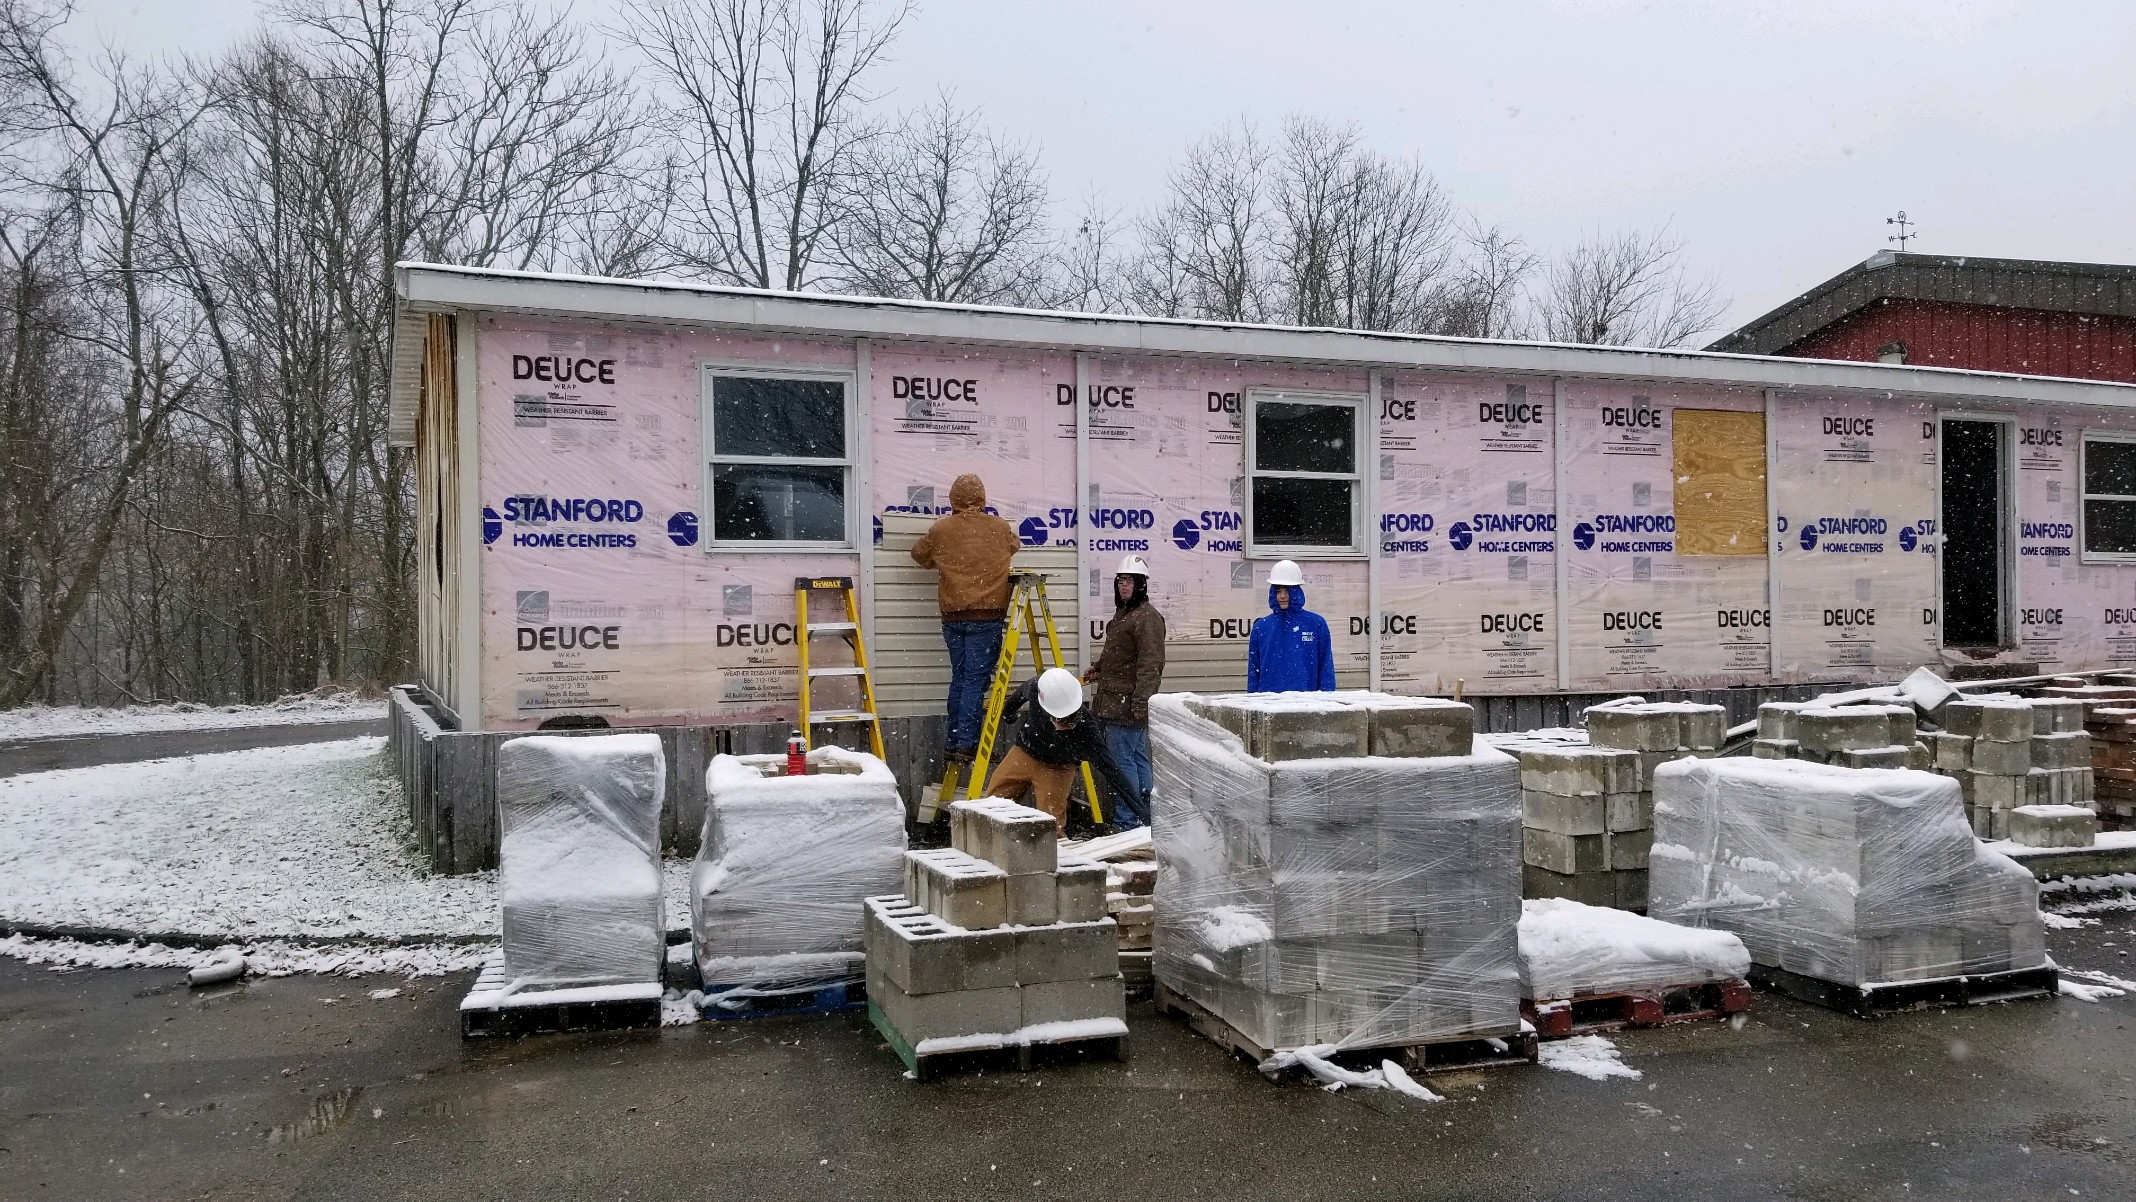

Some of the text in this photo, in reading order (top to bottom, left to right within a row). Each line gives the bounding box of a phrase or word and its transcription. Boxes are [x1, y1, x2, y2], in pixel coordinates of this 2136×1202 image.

[513, 355, 616, 384] DEUCE
[893, 376, 977, 402] DEUCE
[1056, 384, 1135, 409] DUCE
[1480, 402, 1543, 424] DEUCE
[1602, 407, 1661, 428] DEUCE
[1823, 416, 1874, 436] DEUCE
[503, 497, 643, 523] STANFORD
[1473, 514, 1557, 532] STANFORD
[1596, 515, 1675, 533] STANFORD
[1819, 518, 1887, 535] STANFORD
[2021, 523, 2073, 538] TANFORD
[513, 533, 637, 548] HOME CENTERS
[1096, 540, 1149, 551] CENTERS
[1207, 541, 1242, 552] HOME
[1383, 541, 1429, 552] CENTERS
[1479, 541, 1554, 552] HOME CENTERS
[1601, 542, 1673, 552] HOME CENTERS
[1823, 543, 1884, 553] HOME CENTERS
[2021, 546, 2071, 556] OME CENTERS
[1482, 613, 1543, 633] DEUCE
[1603, 611, 1662, 630] DEUCE
[1718, 610, 1770, 627] DEUCE
[1824, 609, 1875, 626] DEUCE
[2104, 608, 2136, 624] DEUC
[717, 623, 799, 647] DEUC
[1210, 618, 1251, 638] DEU
[517, 626, 620, 651] DEUCE
[573, 697, 609, 705] Requirements
